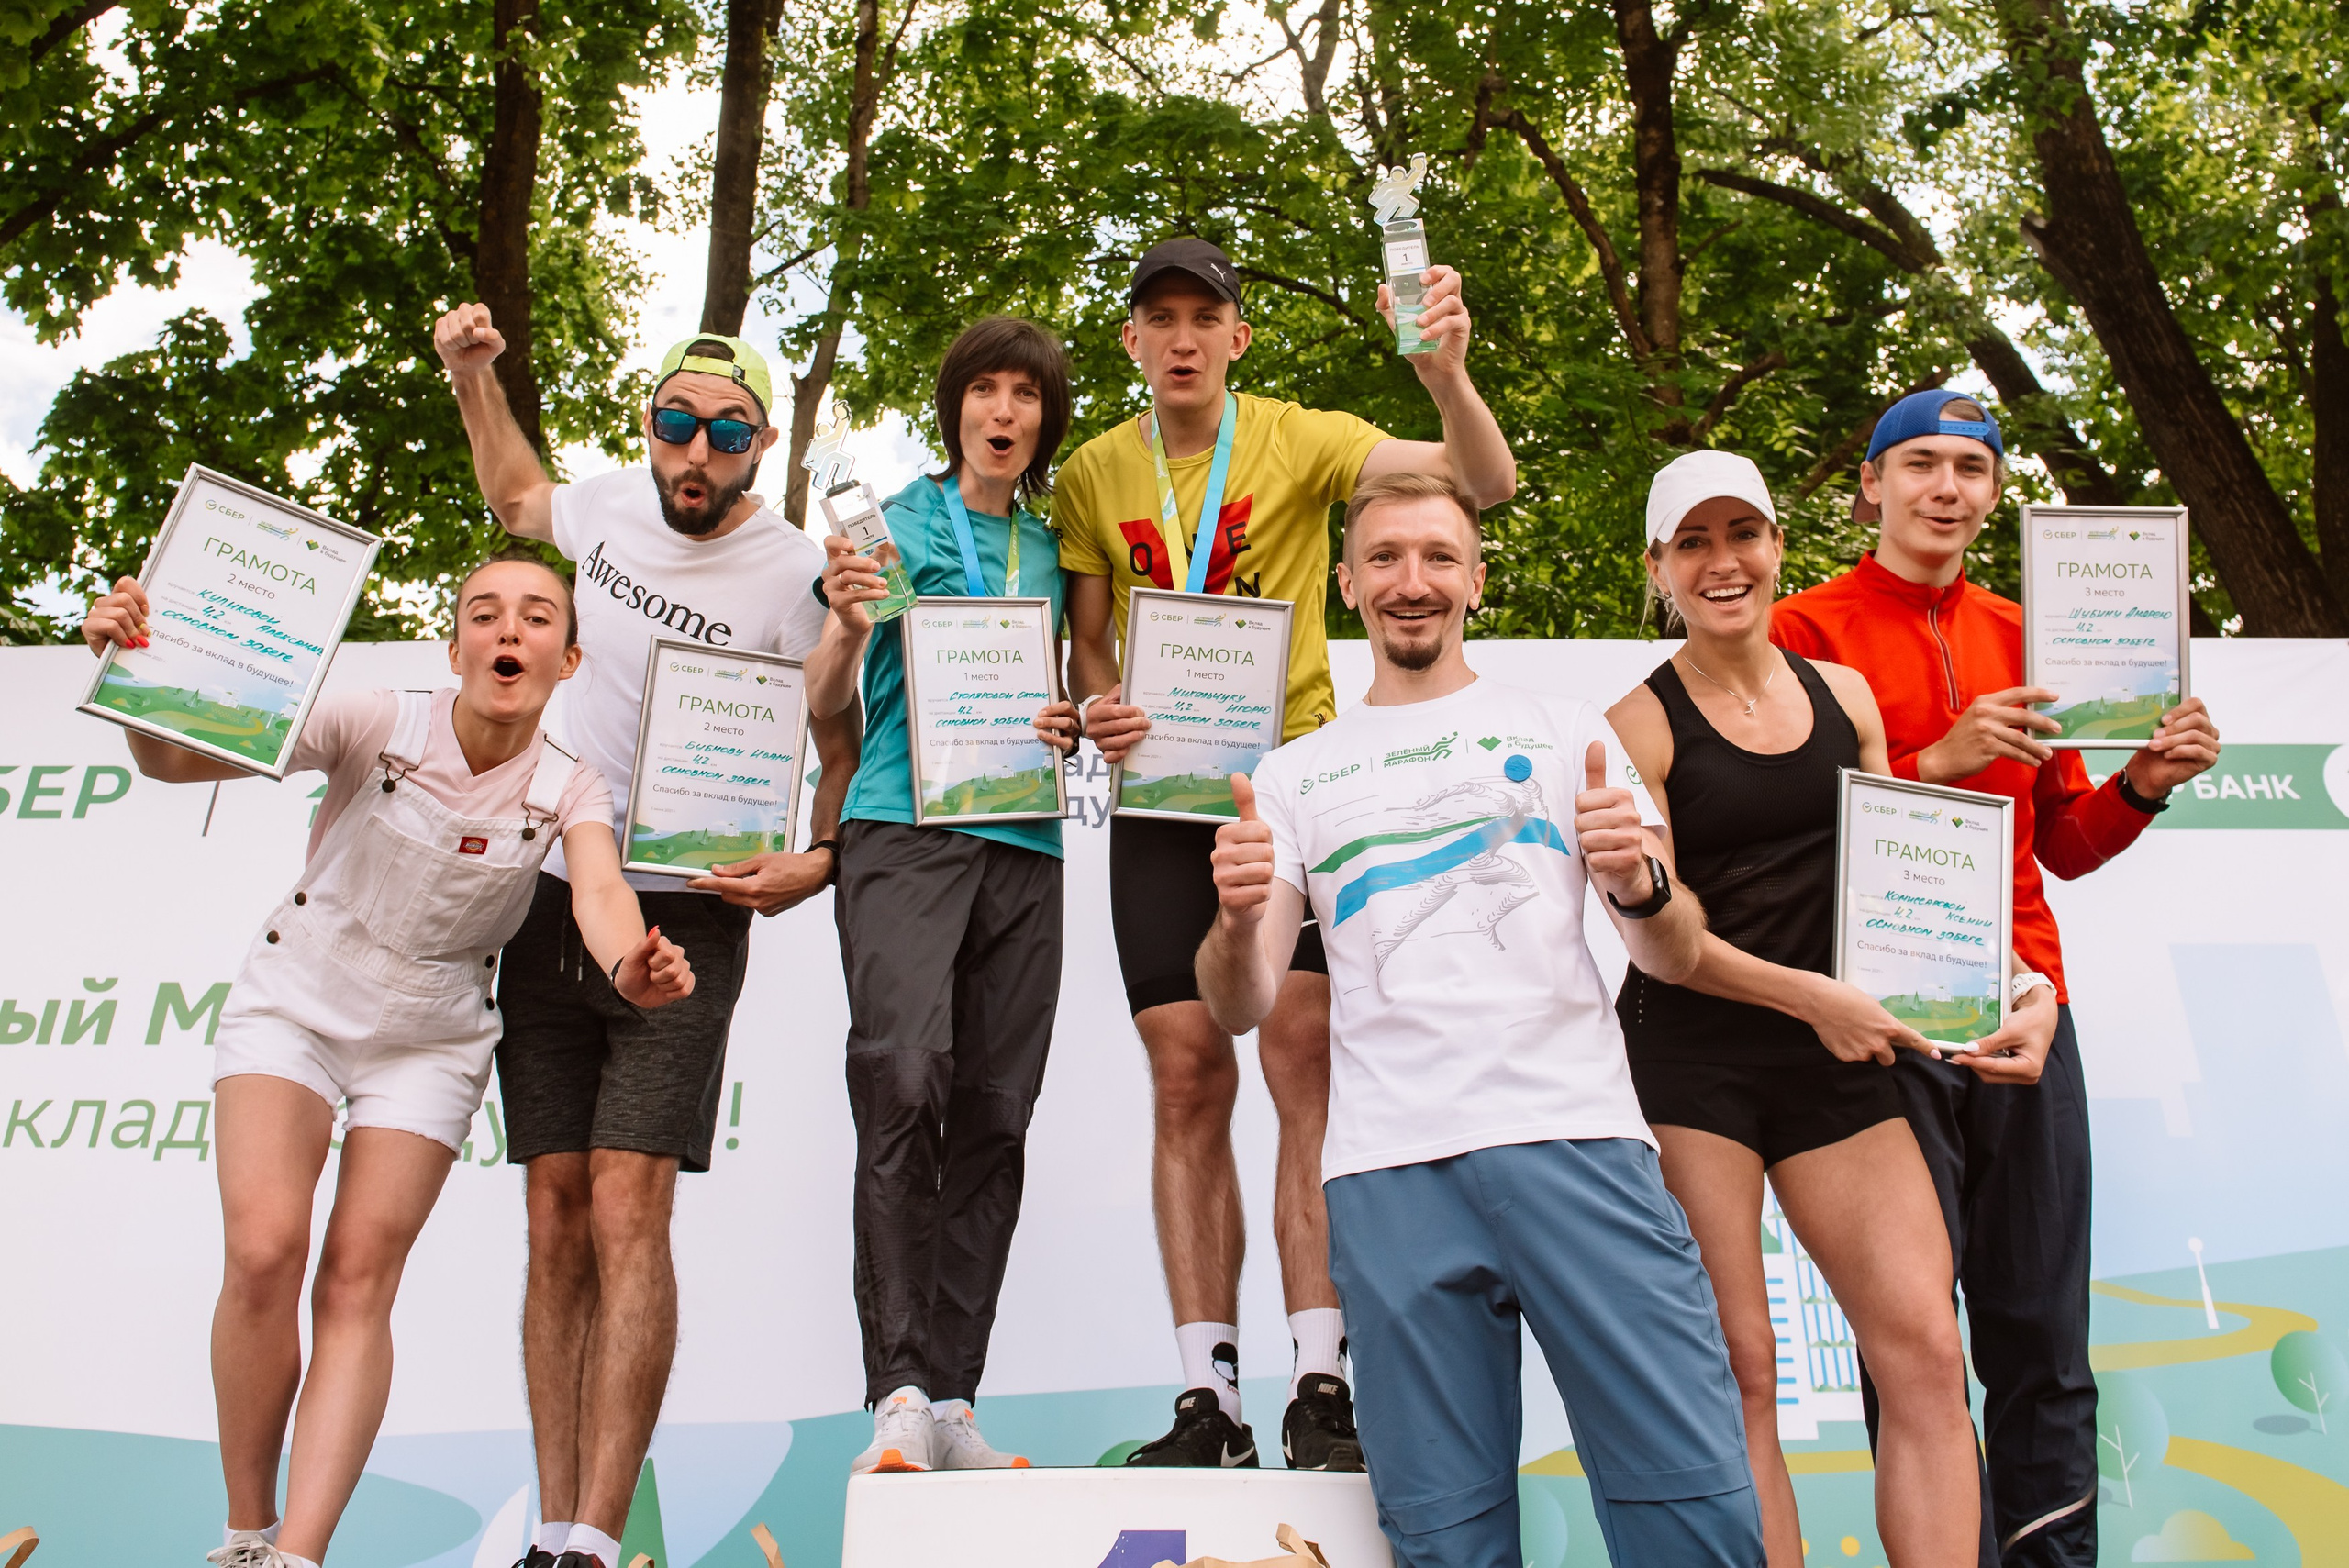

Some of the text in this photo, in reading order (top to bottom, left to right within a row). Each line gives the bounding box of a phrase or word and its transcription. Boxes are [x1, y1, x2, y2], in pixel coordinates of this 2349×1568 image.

[1403, 253, 1408, 261] 1
[218, 506, 245, 520] СБЕР
[862, 526, 869, 536] 1
[203, 537, 316, 595] ГРАМОТА
[2057, 562, 2153, 579] ГРАМОТА
[227, 573, 275, 600] 2 место
[581, 540, 732, 646] Awesome
[2085, 587, 2125, 597] 3 место
[1161, 614, 1184, 622] СБЕР
[937, 650, 1024, 663] ГРАМОТА
[1160, 643, 1255, 666] ГРАМОТА
[191, 644, 204, 654] за
[206, 649, 236, 668] вклад
[246, 662, 294, 688] будущее!
[681, 665, 704, 674] СБЕР
[2044, 658, 2081, 666] Спасибо
[2129, 659, 2167, 668] будущее!
[963, 672, 968, 680] 1
[1186, 669, 1225, 681] 1 место
[678, 695, 774, 723] ГРАМОТА
[704, 722, 744, 736] 2 место
[930, 738, 963, 747] Спасибо
[976, 739, 998, 747] вклад
[1007, 737, 1041, 747] будущее!
[1143, 733, 1174, 742] пасибо
[1187, 737, 1212, 746] вклад
[1221, 740, 1261, 750] будущее!
[1506, 735, 1535, 743] Вклад
[1514, 740, 1553, 751] будущее
[1386, 744, 1431, 758] ЗЕЛЁНЫЙ
[1384, 756, 1431, 768] МАРАФОН
[1319, 763, 1361, 784] СБЕР
[652, 784, 690, 796] Спасибо
[703, 791, 729, 802] вклад
[738, 795, 777, 807] будущее!
[1874, 806, 1897, 815] СБЕР
[1876, 839, 1975, 871] ГРАМОТА
[1903, 870, 1945, 885] 3 место
[1857, 940, 1897, 954] Спасибо
[1898, 948, 1908, 956] за
[1910, 950, 1936, 962] вклад
[1945, 954, 1987, 969] будущее!
[1317, 1382, 1339, 1396] NIKE
